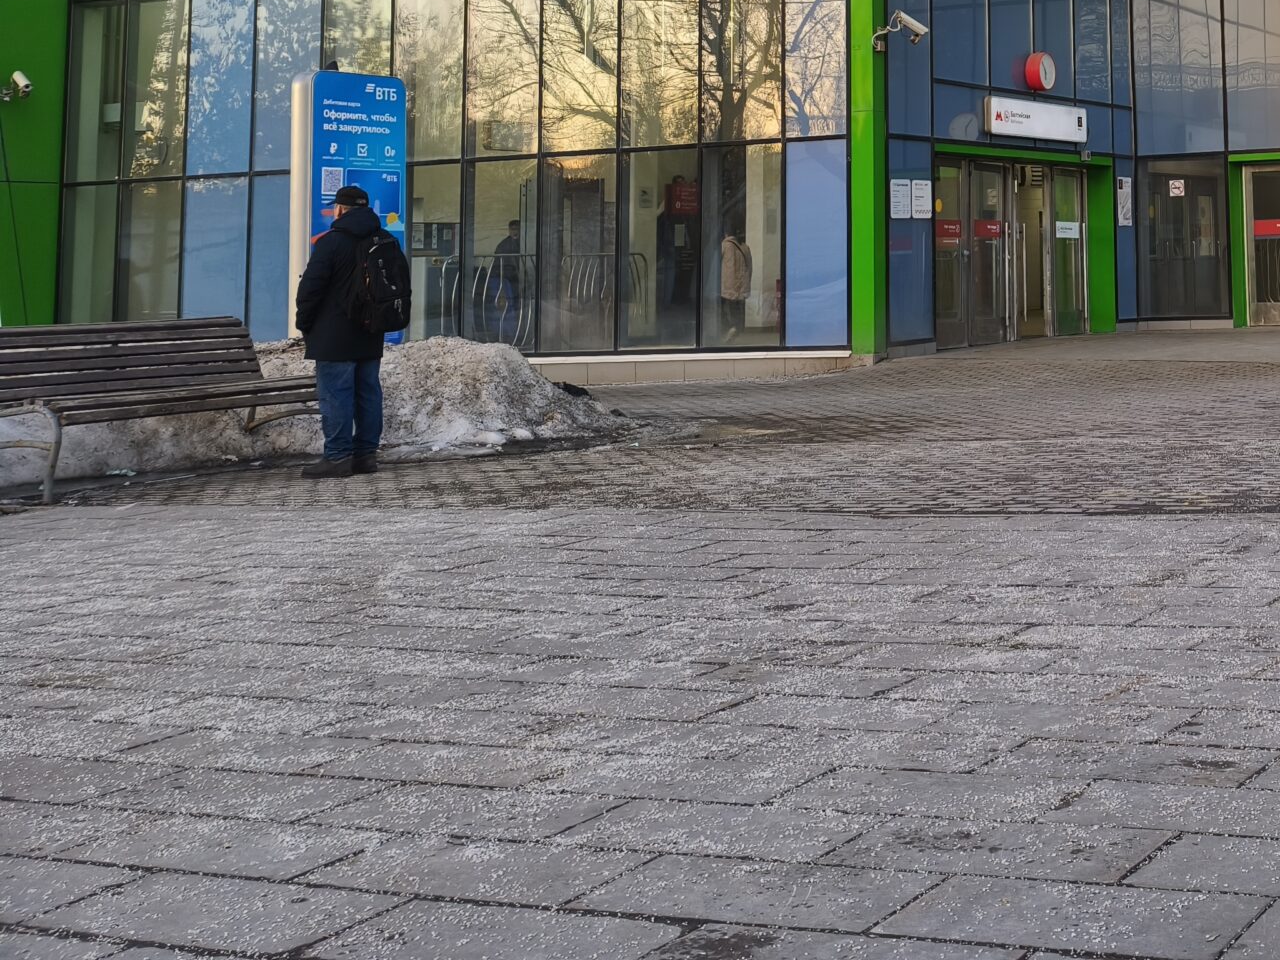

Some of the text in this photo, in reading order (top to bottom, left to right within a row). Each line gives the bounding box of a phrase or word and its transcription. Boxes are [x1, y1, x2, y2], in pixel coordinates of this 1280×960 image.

[376, 87, 397, 101] ВТБ
[323, 109, 397, 123] Оформите, чтобы
[323, 122, 391, 135] всё закрутилось
